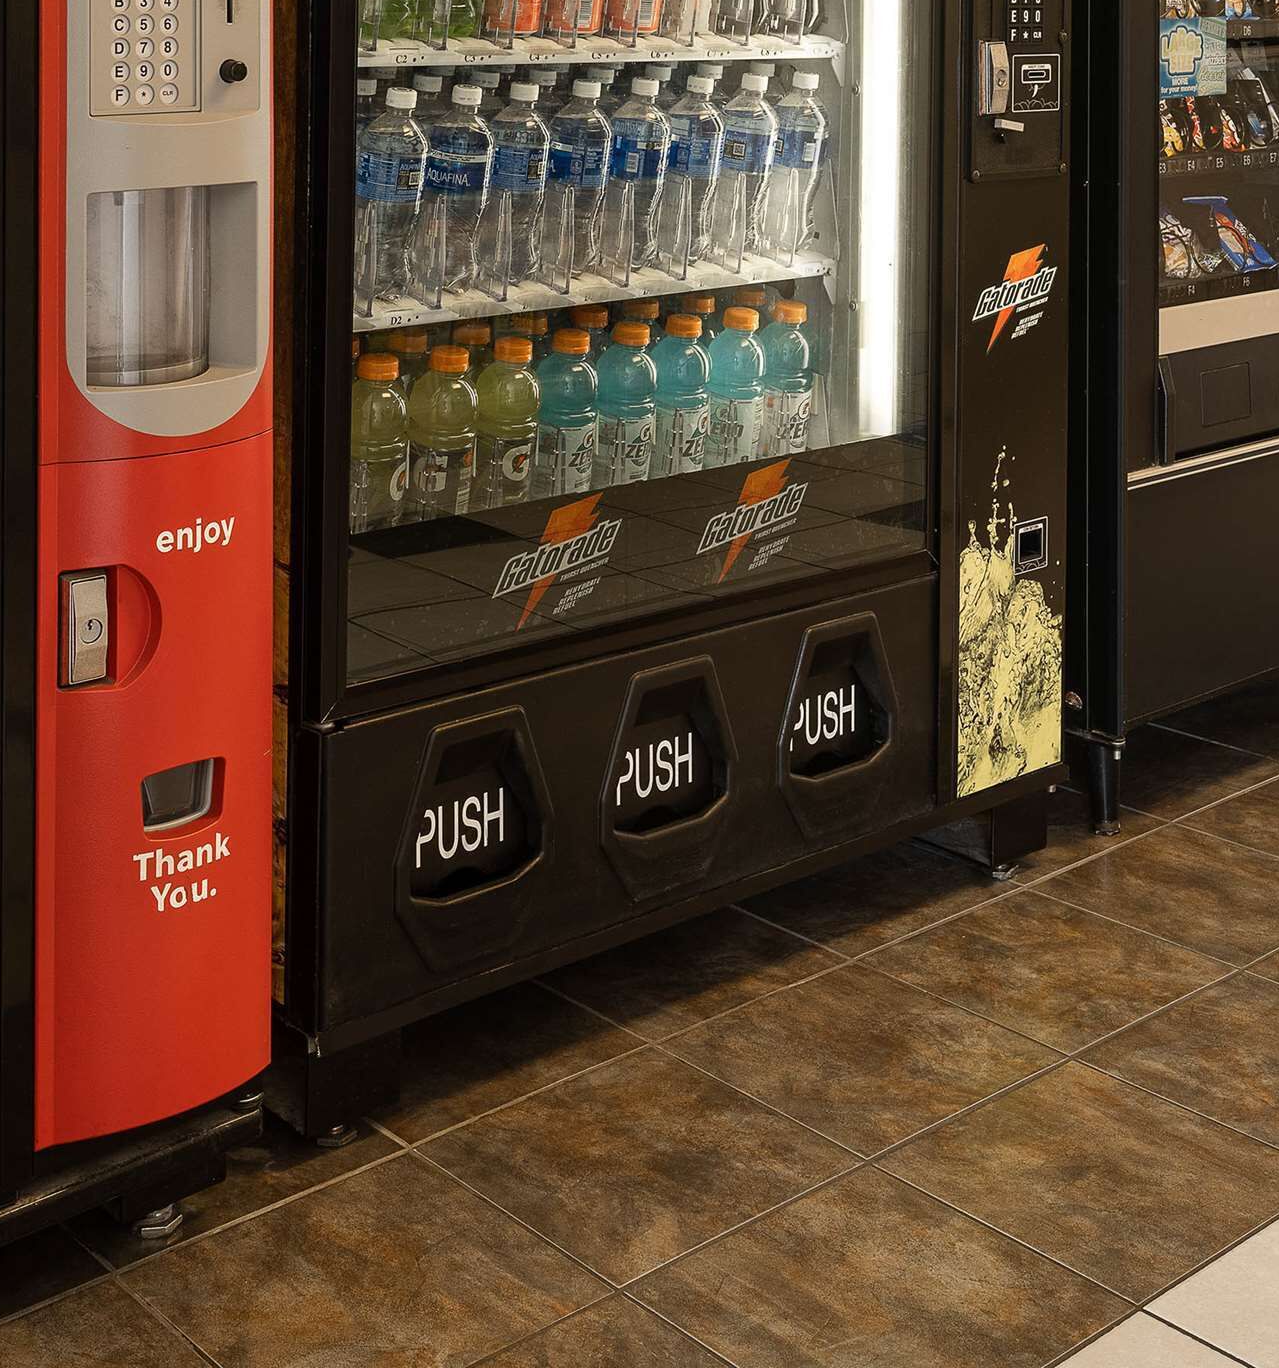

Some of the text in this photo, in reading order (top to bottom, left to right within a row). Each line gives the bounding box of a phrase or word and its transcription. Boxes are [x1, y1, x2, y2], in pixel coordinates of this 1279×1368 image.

[113, 18, 172, 32] C 5 6
[114, 41, 172, 55] D 7 8
[115, 64, 172, 78] E 9 0
[115, 88, 124, 102] F
[1216, 157, 1224, 168] E5
[1243, 154, 1251, 165] E6
[1270, 152, 1277, 163] E7
[1187, 160, 1195, 170] E4
[427, 167, 468, 186] AQUAFINA
[972, 266, 1058, 322] Gatorade
[1187, 284, 1195, 294] F4
[389, 316, 403, 326] D2
[696, 482, 809, 555] Gatorade
[156, 516, 236, 554] enjoy
[491, 518, 624, 599] Gatorade
[616, 731, 693, 806] PUSH
[415, 786, 505, 869] PUSH
[132, 832, 231, 883] Thank
[150, 873, 218, 913] You.
